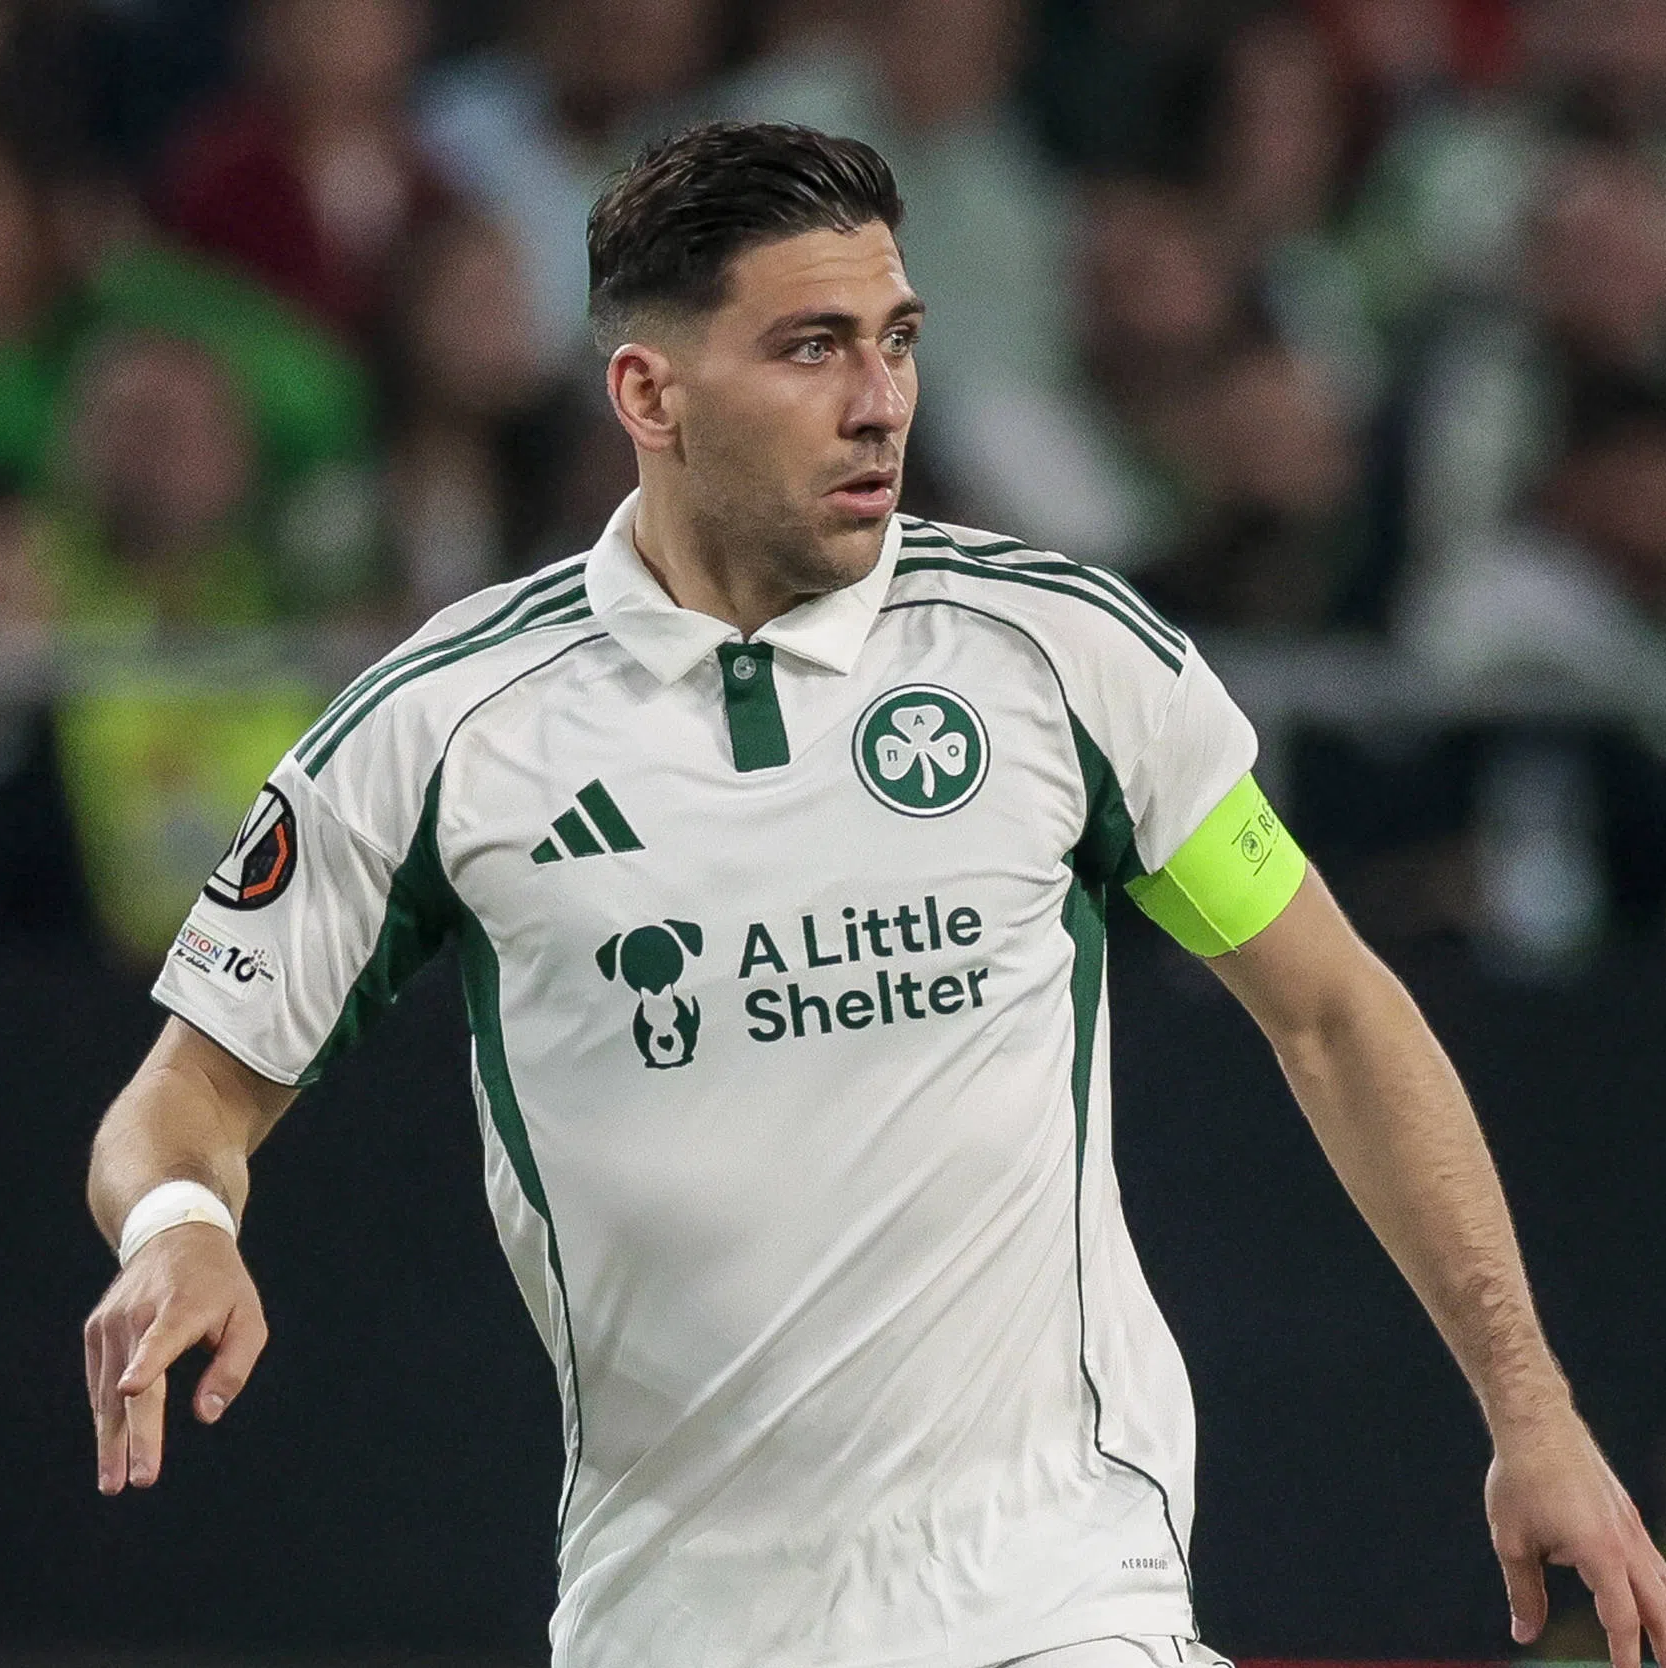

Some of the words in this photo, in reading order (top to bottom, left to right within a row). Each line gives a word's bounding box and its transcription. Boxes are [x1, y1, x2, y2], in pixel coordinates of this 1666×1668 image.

[737, 922, 789, 979] A
[801, 895, 982, 969] Little
[744, 966, 989, 1043] Shelter
